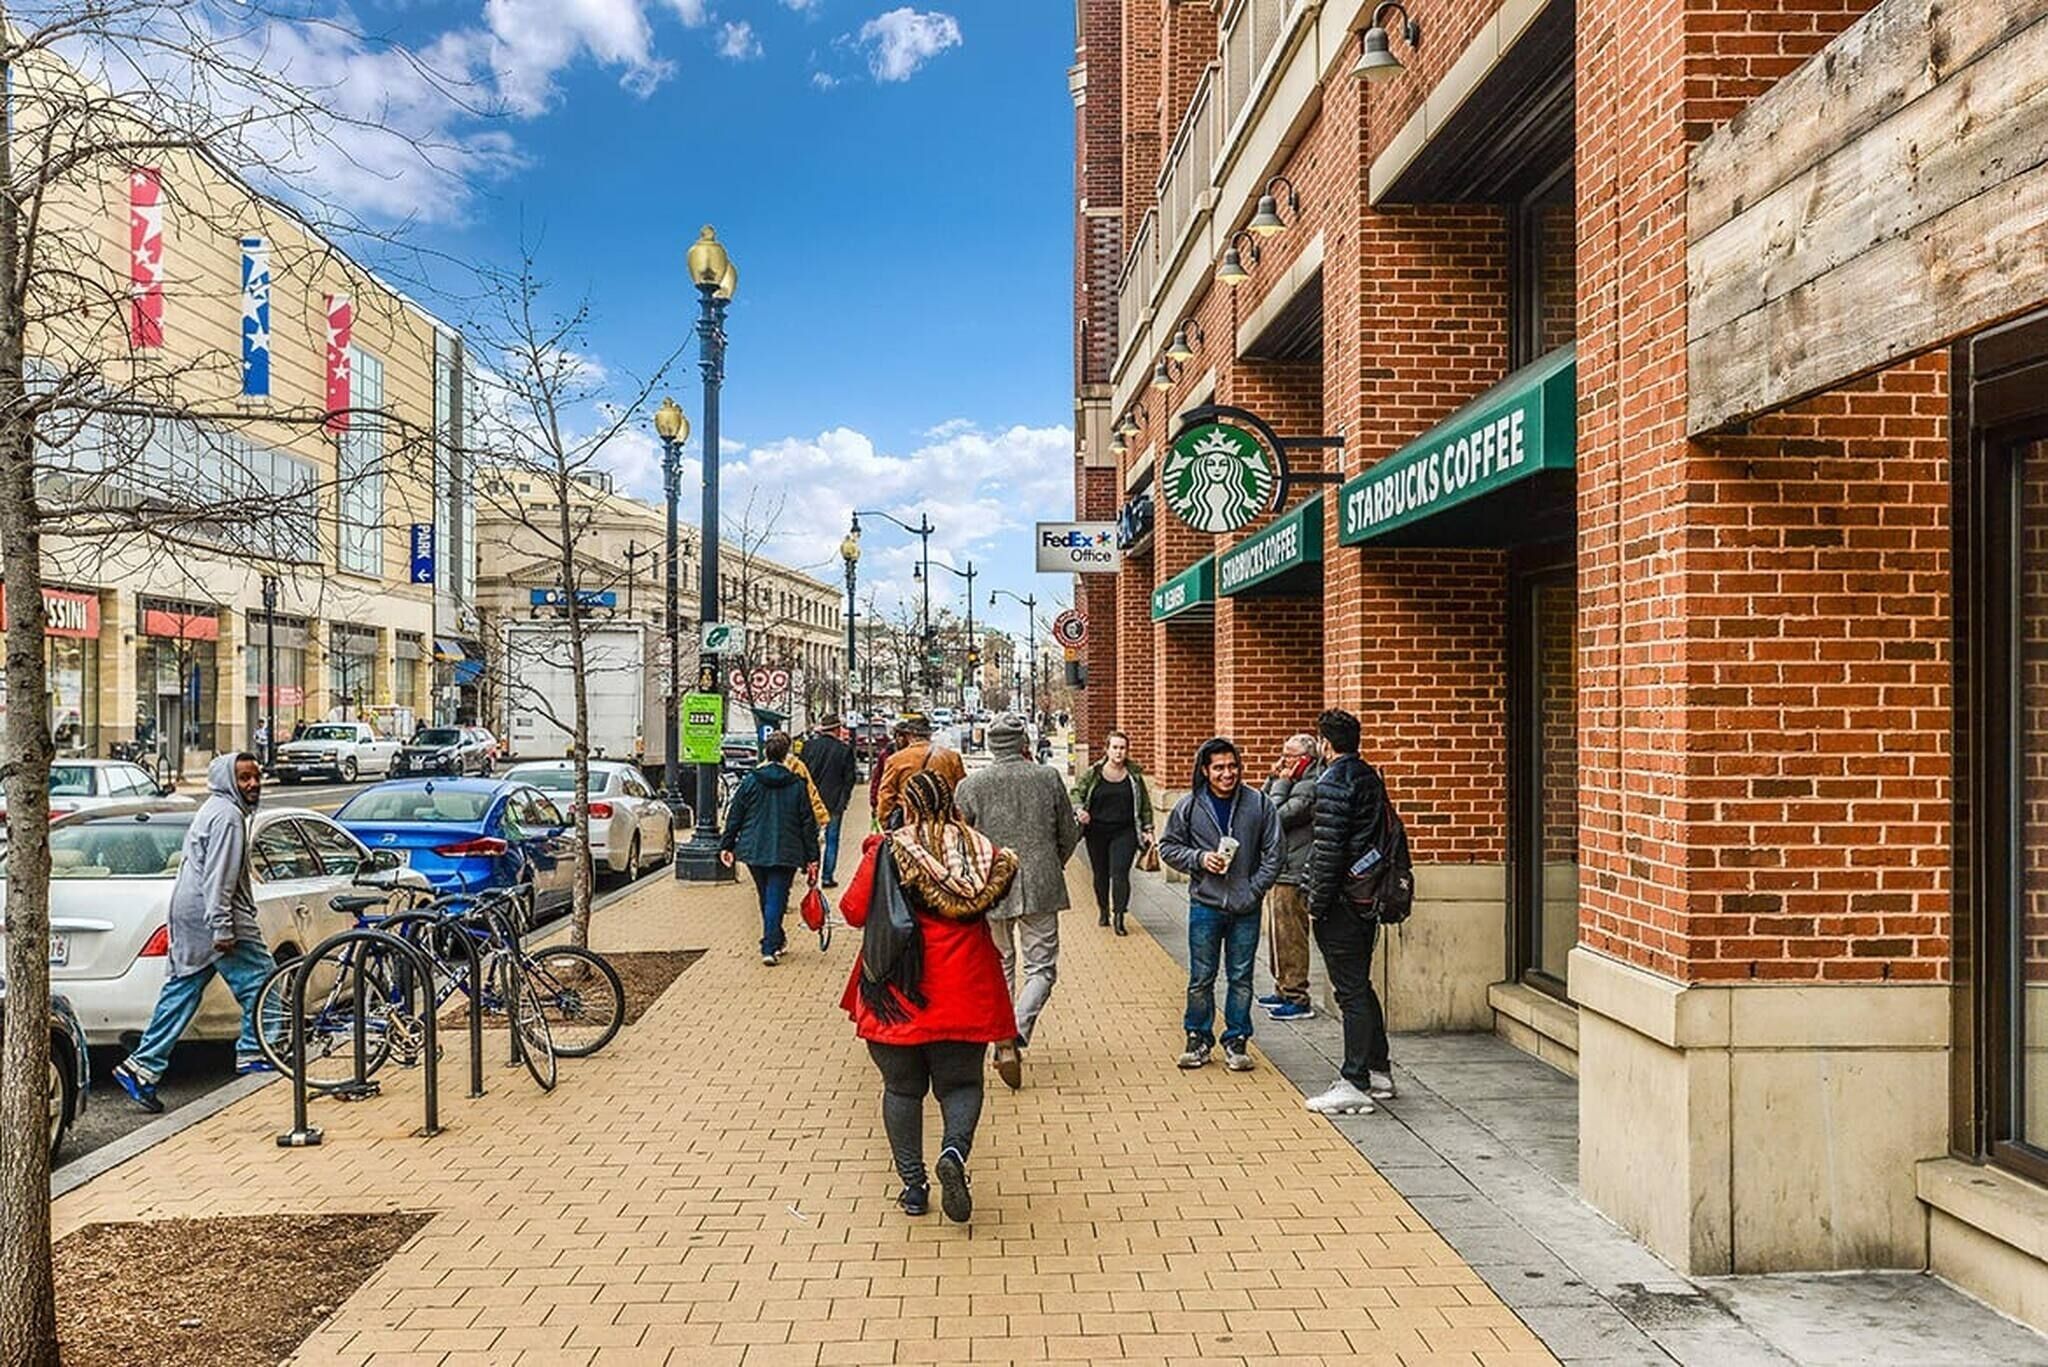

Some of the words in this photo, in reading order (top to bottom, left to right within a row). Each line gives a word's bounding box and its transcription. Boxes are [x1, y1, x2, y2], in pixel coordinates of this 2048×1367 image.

[1347, 452, 1441, 534] STARBUCKS
[1442, 408, 1525, 496] COFFEE
[417, 524, 431, 560] PARK
[1042, 531, 1093, 547] FedEx
[1070, 548, 1112, 563] Office
[1265, 521, 1297, 571] COFFEE
